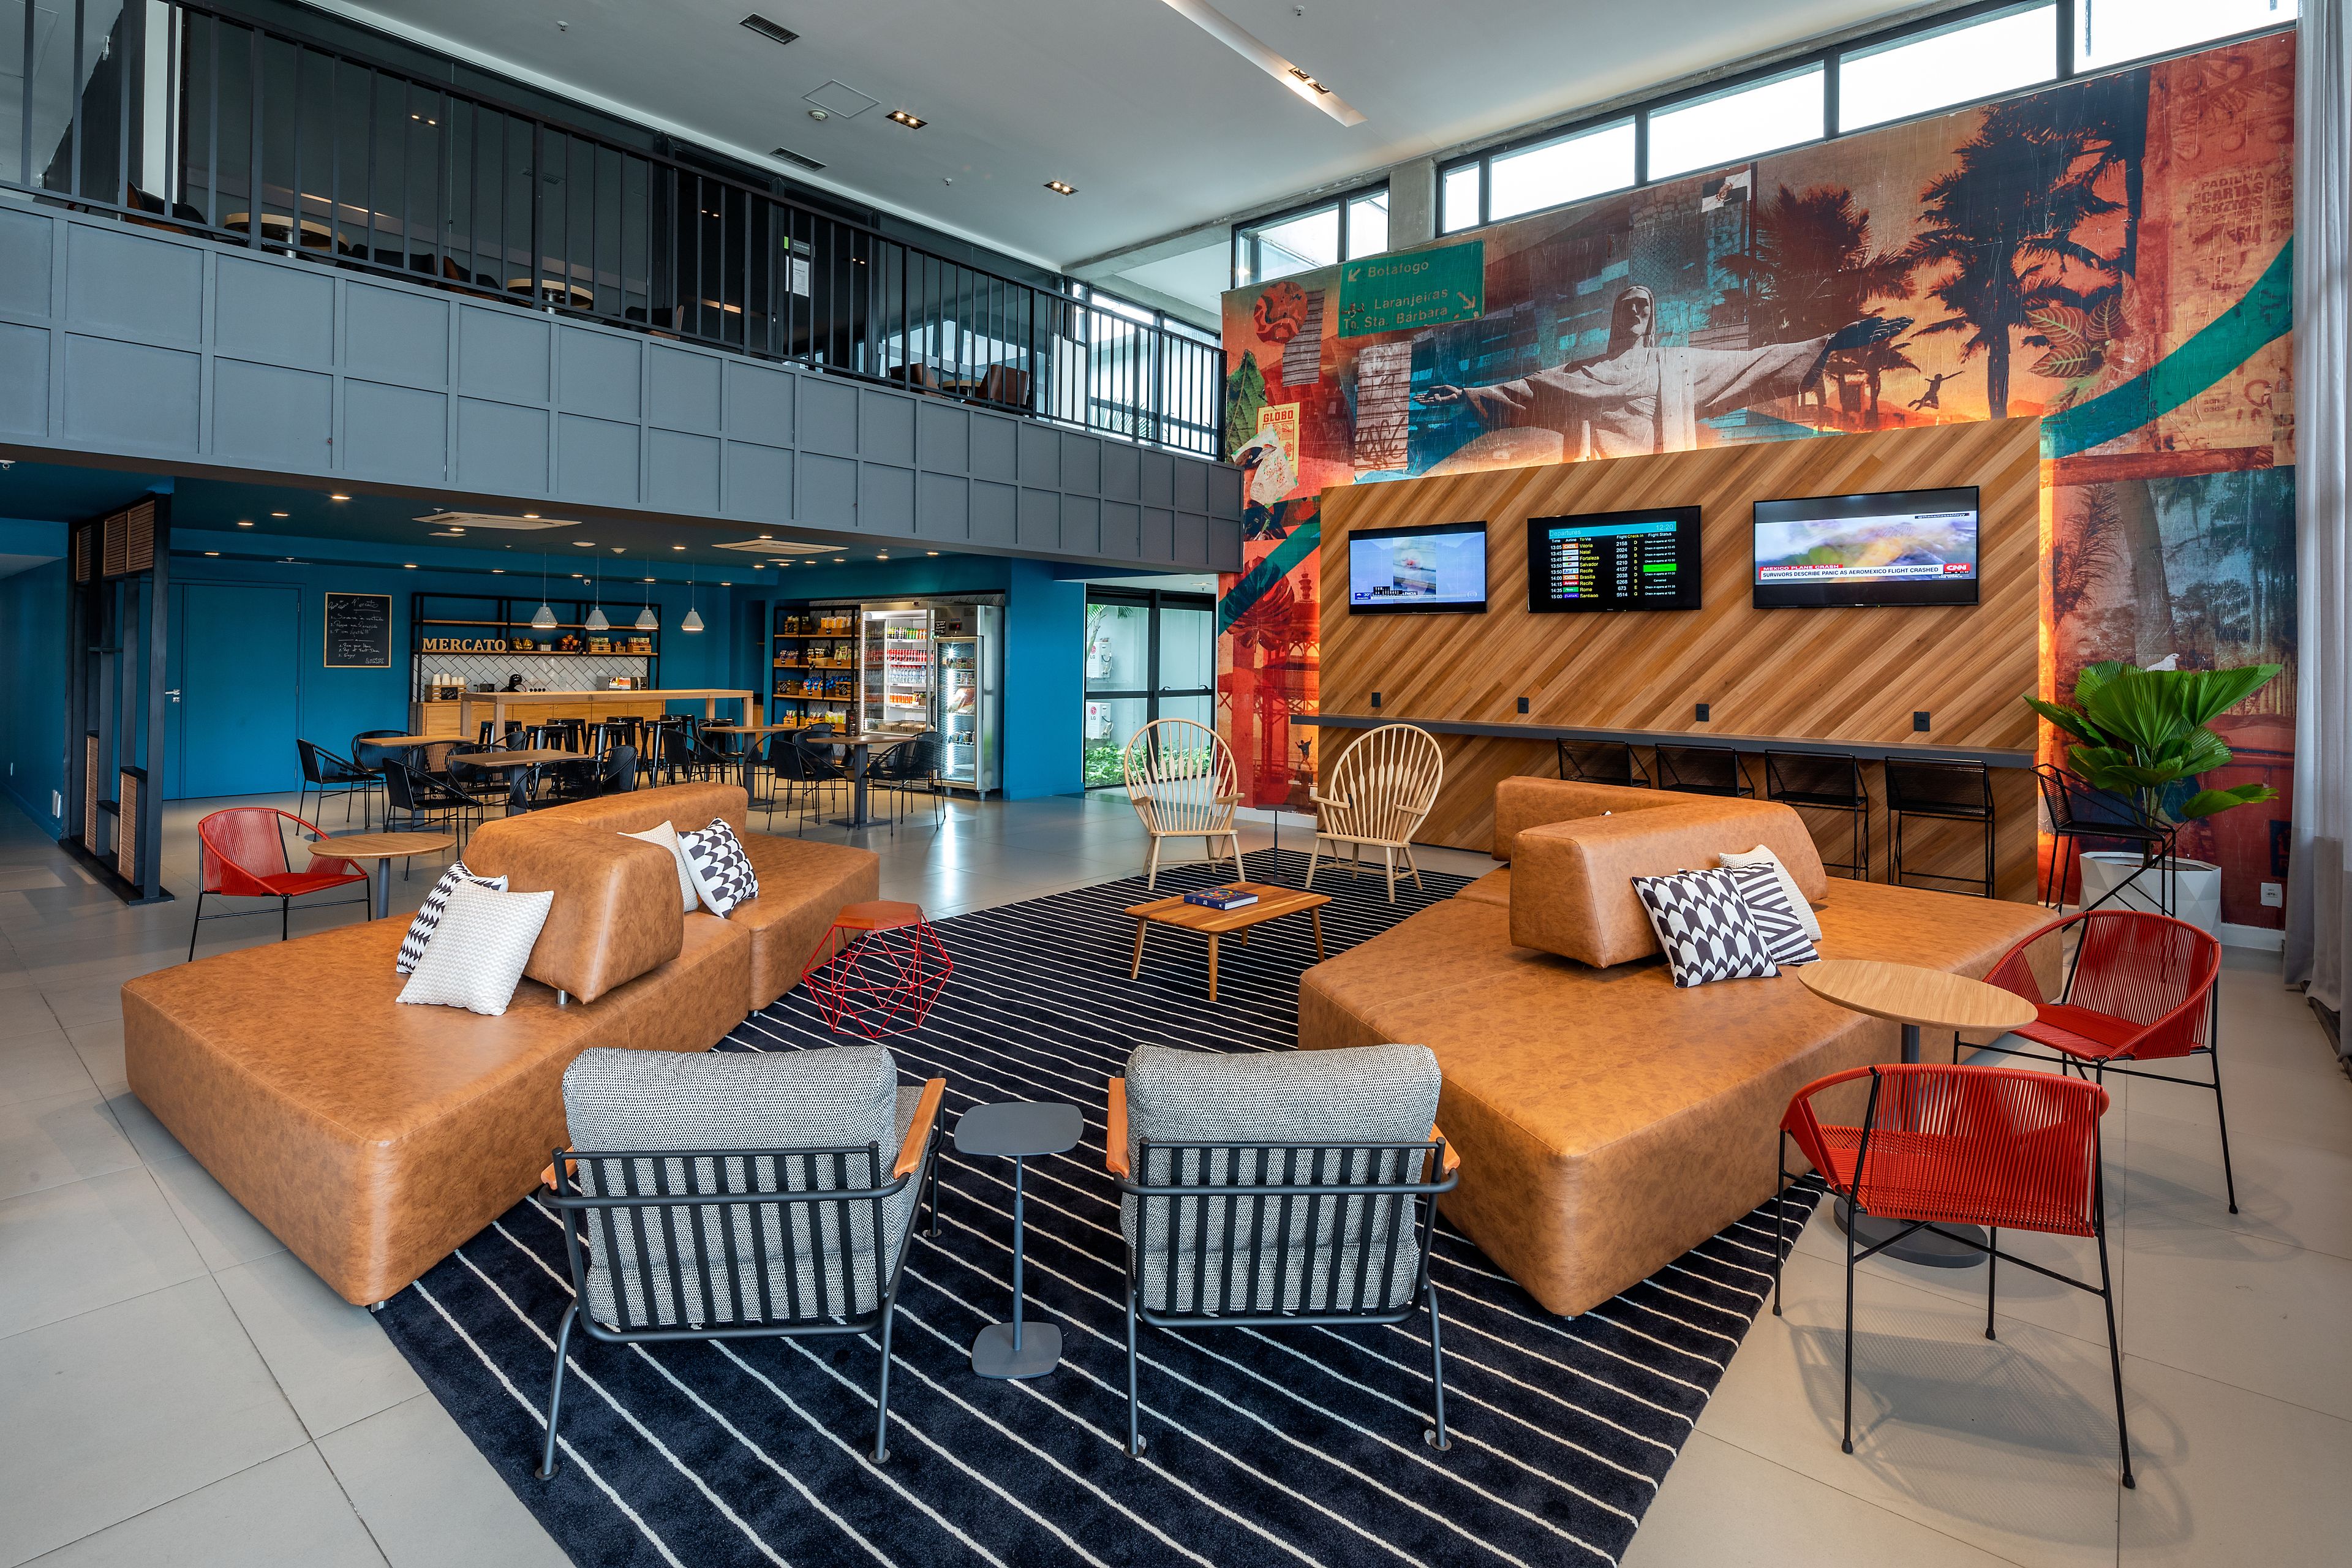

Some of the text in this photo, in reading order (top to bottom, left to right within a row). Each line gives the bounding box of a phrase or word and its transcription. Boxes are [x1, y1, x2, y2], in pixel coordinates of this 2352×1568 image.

[1374, 288, 1448, 310] Laranjeiras
[1365, 316, 1389, 328] Sta.
[1396, 306, 1448, 325] Bárbara
[1264, 410, 1294, 423] GLOBO
[351, 597, 379, 608] Mercato
[422, 638, 507, 651] MERCATO
